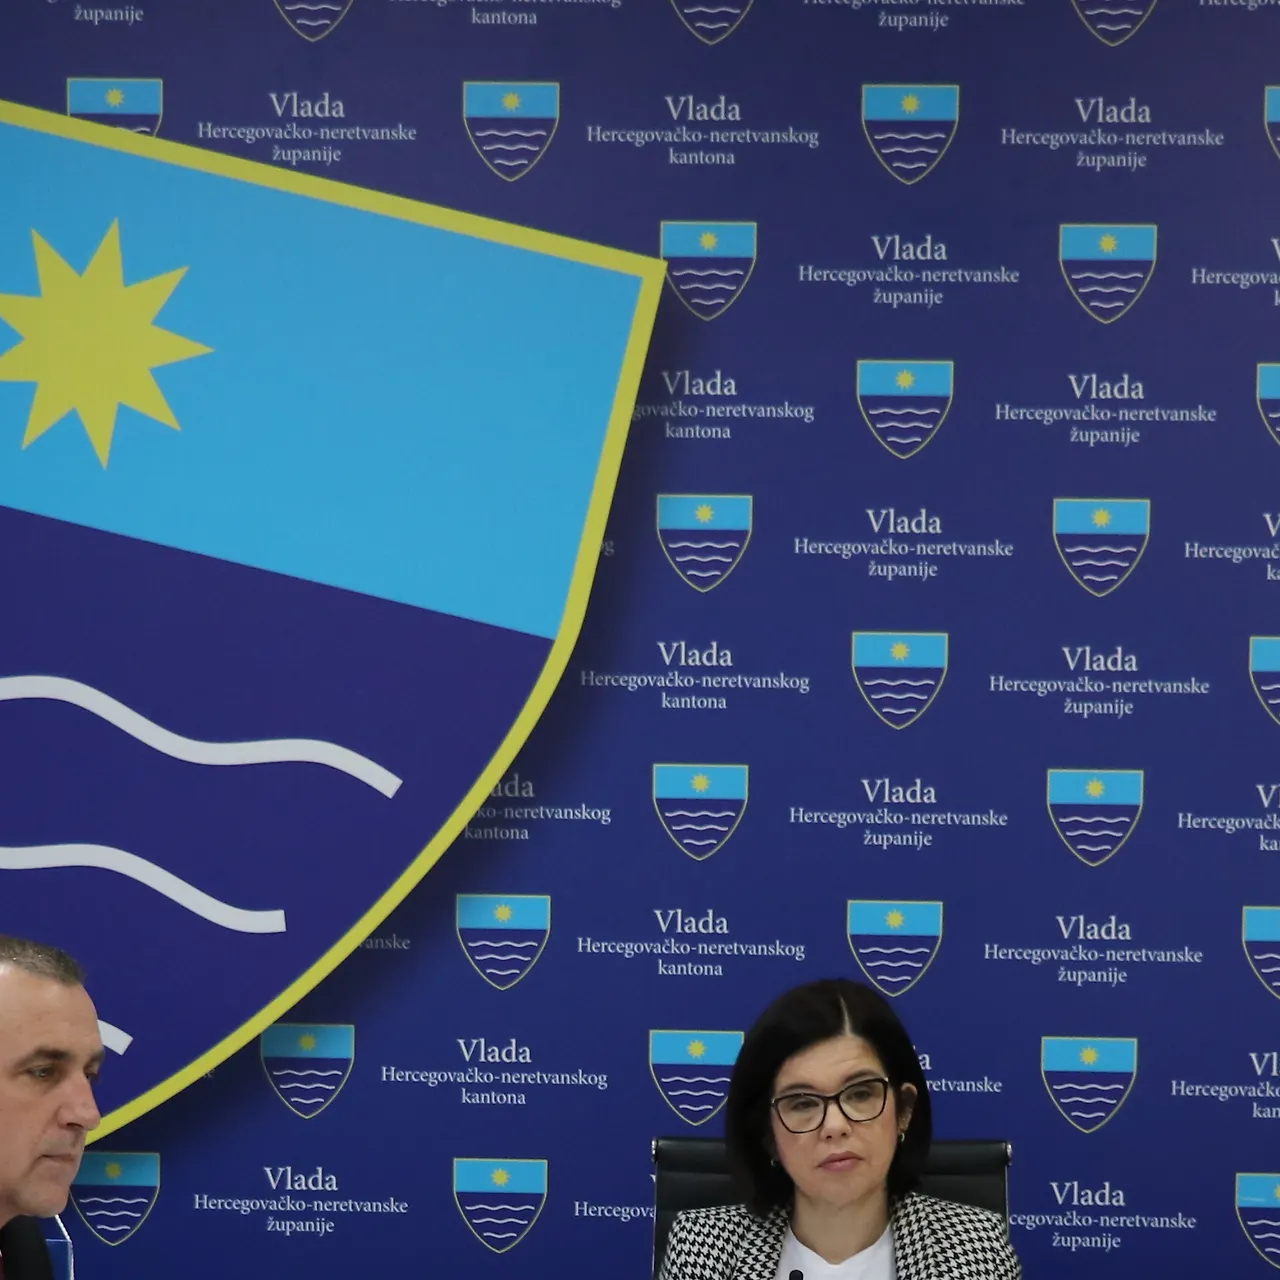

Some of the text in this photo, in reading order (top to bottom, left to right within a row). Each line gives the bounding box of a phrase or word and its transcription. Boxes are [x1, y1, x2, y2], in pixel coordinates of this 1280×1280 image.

[75, 5, 143, 25] županije
[472, 8, 537, 24] kantona
[879, 11, 949, 31] županije
[269, 92, 345, 118] Vlada
[664, 95, 742, 121] Vlada
[1075, 96, 1151, 123] Vlada
[199, 122, 416, 144] Hercegovačko-neretvanske
[587, 126, 819, 148] Hercegovačko-neretvanskog
[1002, 128, 1224, 150] Hercegovačko-neretvanske
[273, 145, 341, 166] županije
[669, 147, 735, 164] kantona
[1077, 151, 1147, 172] županije
[871, 234, 947, 260] Vlada
[799, 265, 1019, 286] Hercegovačko-neretvanske
[874, 288, 943, 308] županije
[662, 370, 737, 396] Vlada
[1068, 373, 1144, 400] Vlada
[633, 401, 814, 422] govačko-neretvanskog
[996, 404, 1216, 425] Hercegovačko-neretvanske
[666, 422, 731, 438] kantona
[1070, 426, 1140, 447] županije
[866, 508, 942, 534] Vlada
[794, 537, 1013, 559] Hercegovačko-neretvanske
[868, 560, 938, 581] županije
[657, 641, 733, 667] Vlada
[1062, 645, 1138, 672] Vlada
[582, 670, 810, 694] Hercegovačko-neretvanskog
[990, 675, 1210, 697] Hercegovačko-neretvanske
[662, 691, 727, 709] kantona
[1064, 697, 1133, 719] županije
[490, 774, 535, 798] ada
[861, 778, 937, 804] Vlada
[790, 807, 1008, 828] Hercegovačko-neretvanske
[465, 825, 529, 840] kantona
[864, 829, 932, 850] županije
[654, 909, 729, 934] Vlada
[1056, 914, 1132, 940] Vlada
[577, 937, 805, 961] Hercegovačko-neretvanskog
[984, 944, 1203, 965] Hercegovačko-neretvanske
[658, 959, 723, 976] kantona
[1058, 966, 1127, 987] županije
[457, 1038, 532, 1063] Vlada
[381, 1066, 608, 1089] Hercegovačko-neretvanskog
[462, 1088, 526, 1104] kantona
[264, 1166, 338, 1191] Vlada
[194, 1194, 409, 1214] Hercegovačko-neretvanske
[1050, 1181, 1126, 1208] Vlada
[267, 1216, 335, 1236] županije
[1009, 1212, 1197, 1231] cegovačko-neretvanske
[1052, 1232, 1121, 1252] županije
